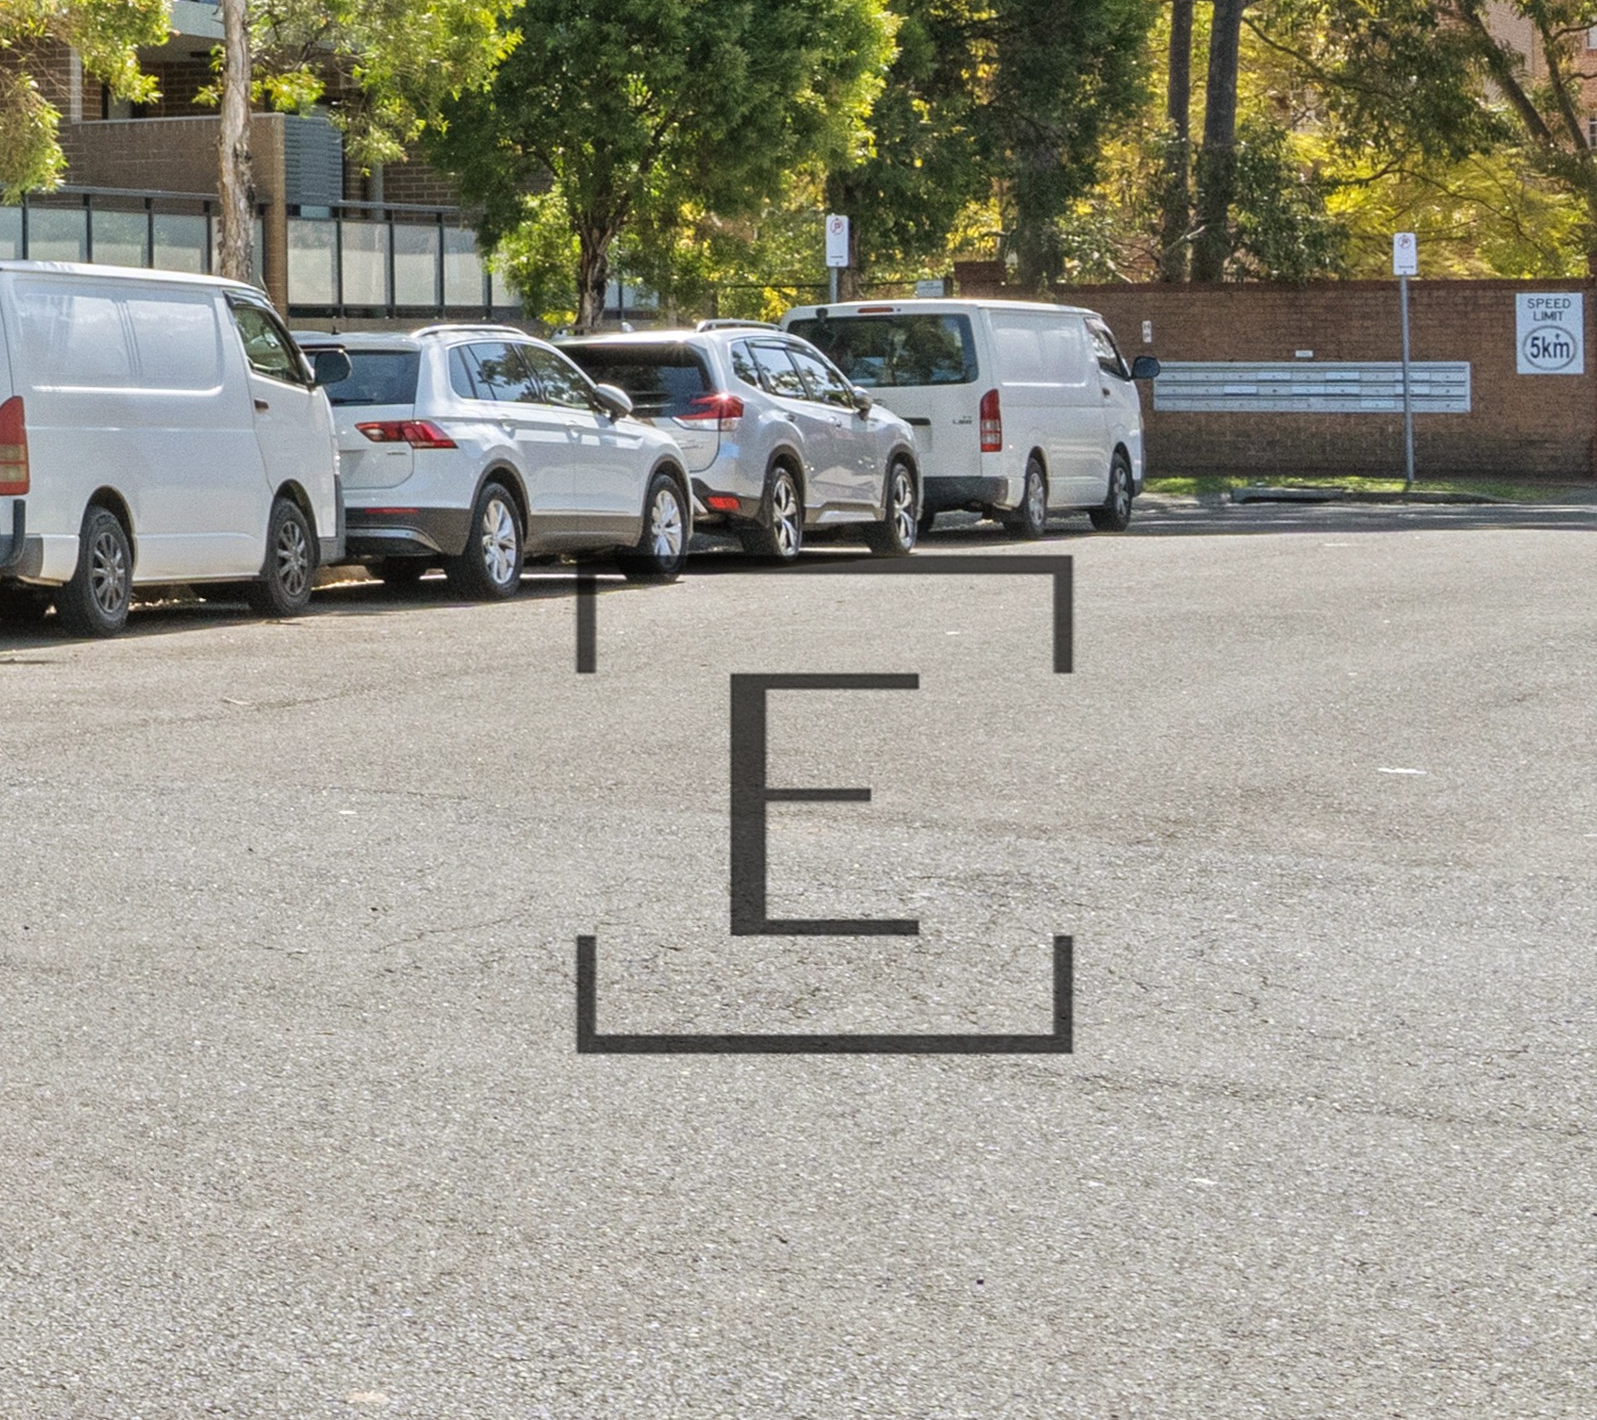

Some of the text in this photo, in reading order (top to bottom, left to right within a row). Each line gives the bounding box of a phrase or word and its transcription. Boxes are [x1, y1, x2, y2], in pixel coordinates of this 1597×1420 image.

[1527, 298, 1571, 309] SPEED
[1533, 311, 1564, 321] LIMIT
[1530, 336, 1570, 359] 5km
